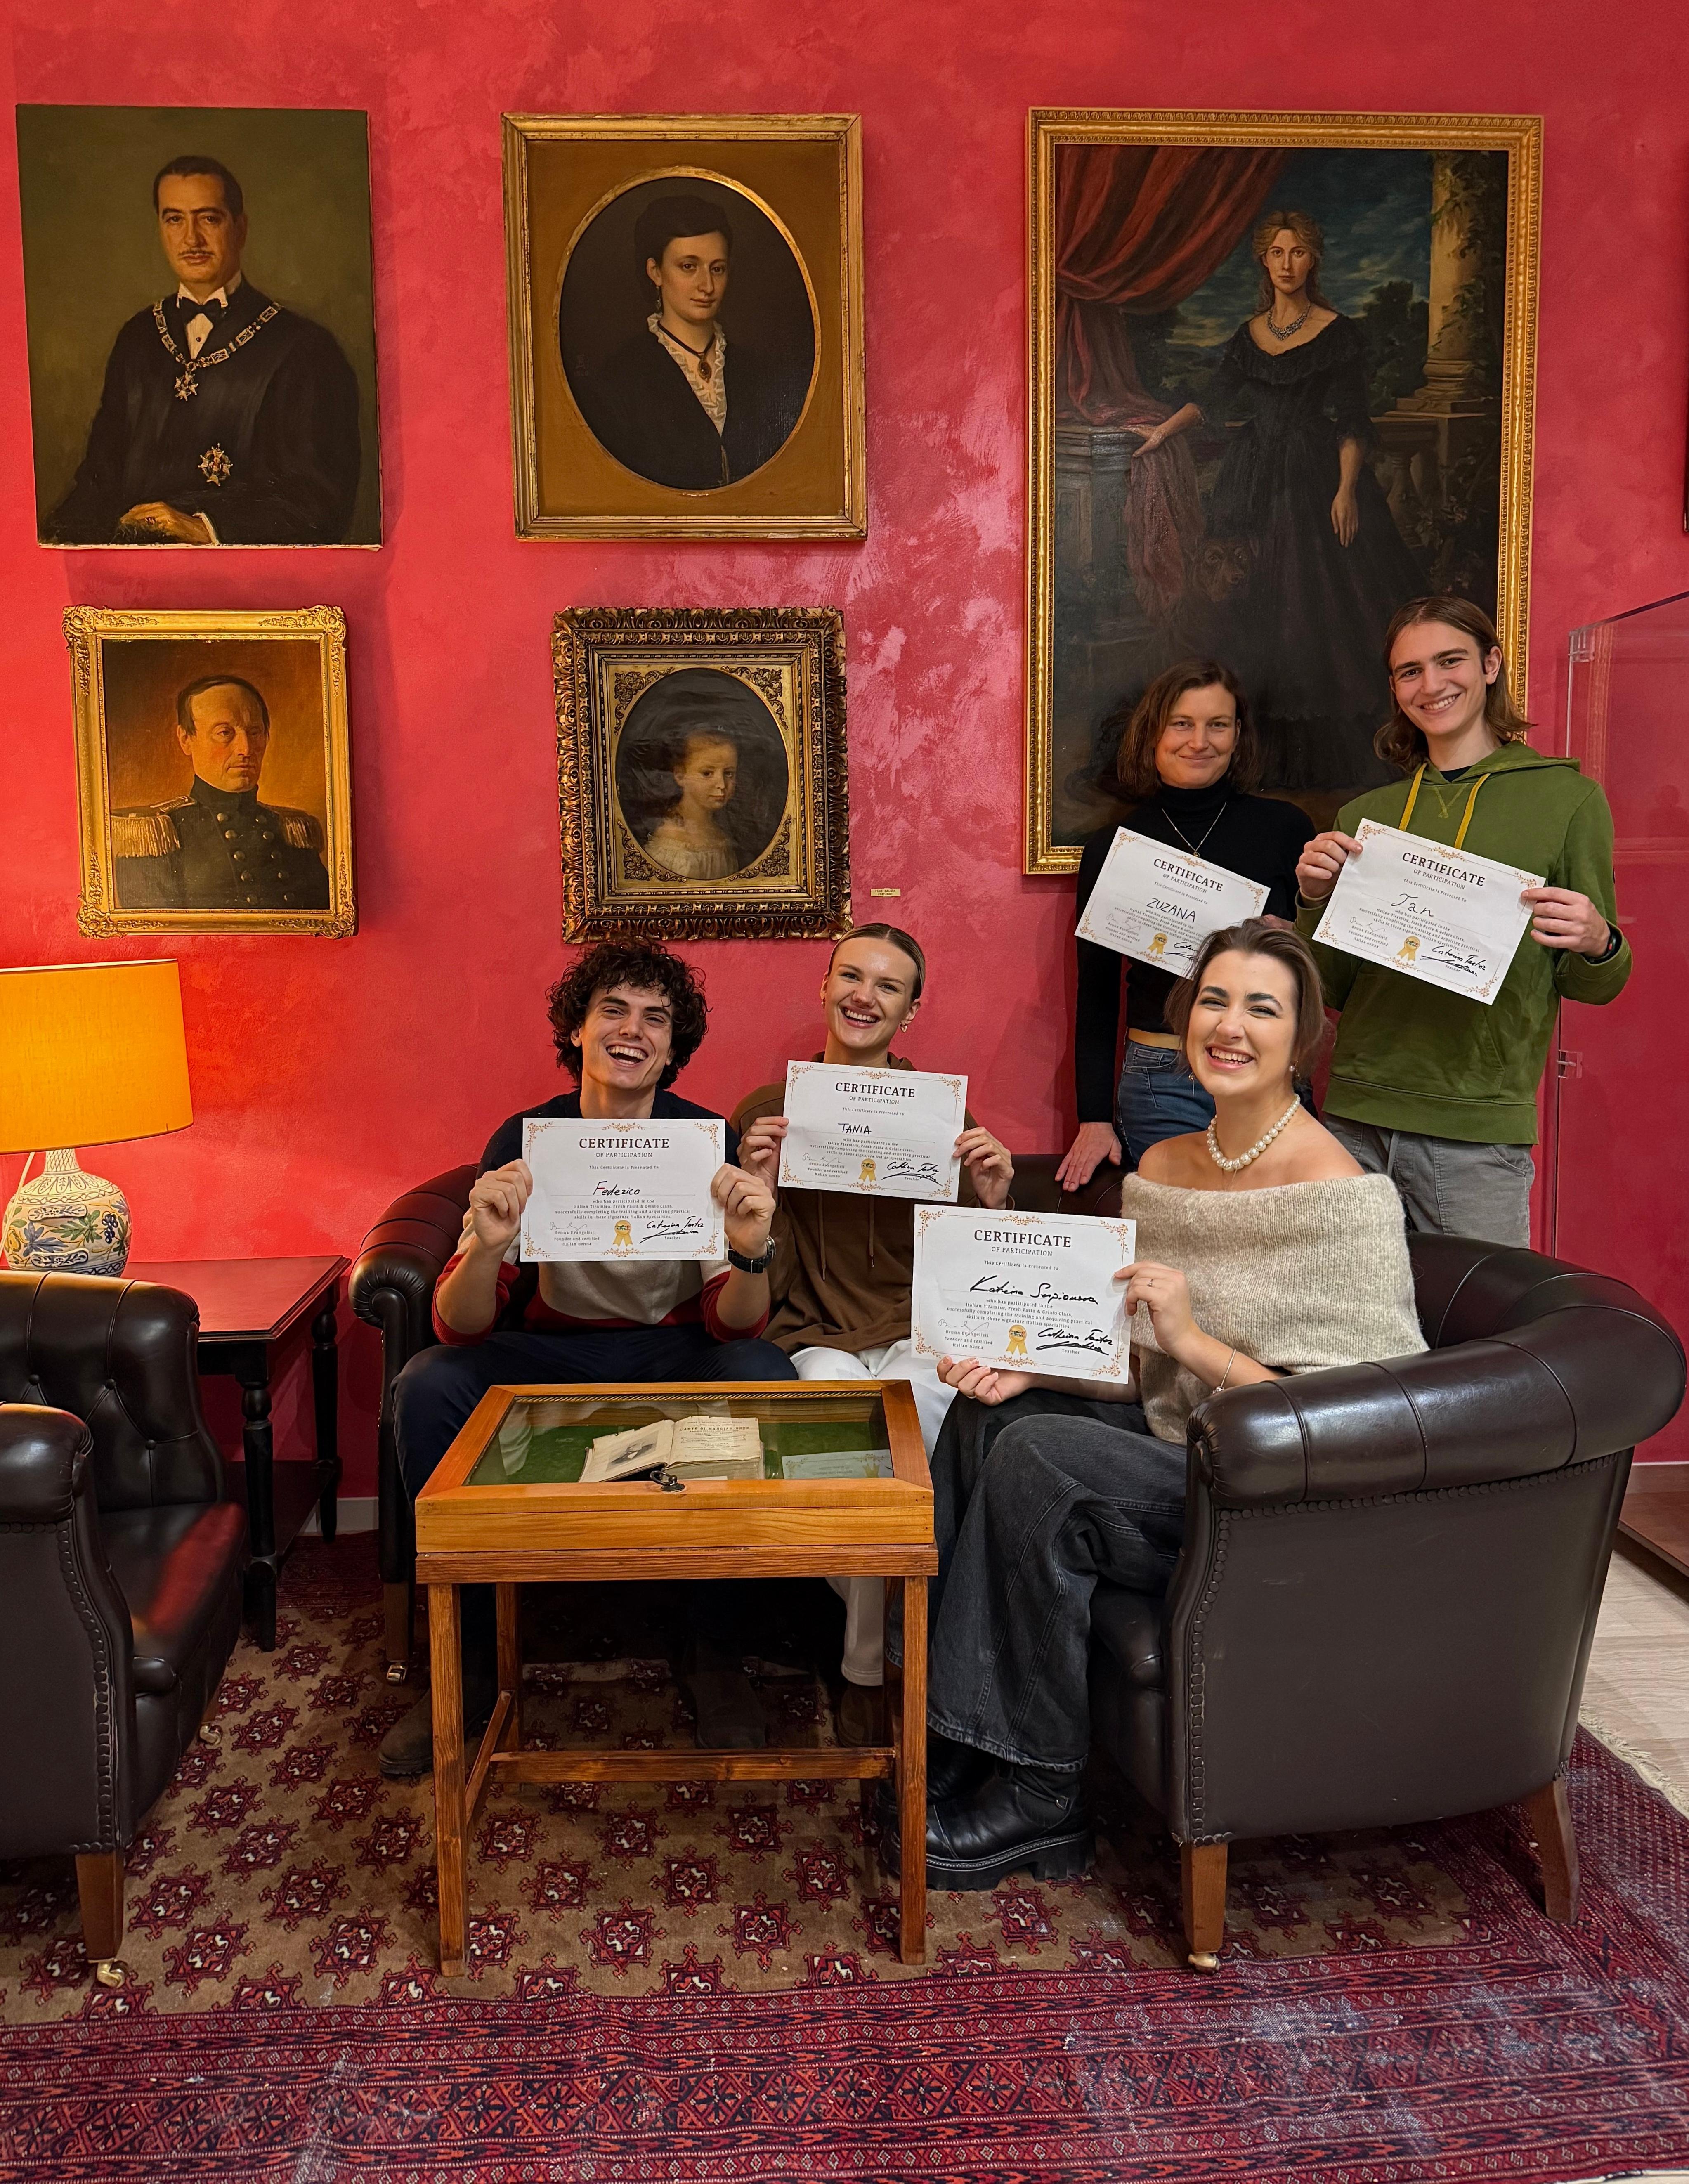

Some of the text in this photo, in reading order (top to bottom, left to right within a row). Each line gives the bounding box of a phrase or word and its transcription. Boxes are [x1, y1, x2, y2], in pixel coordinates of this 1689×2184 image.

[1153, 858, 1223, 891] CERTIFICATE
[1402, 852, 1485, 886] CERTIFICATE
[1170, 876, 1207, 893] PARTICIPATION
[1422, 872, 1465, 890] PARTICIPATION
[1146, 898, 1195, 923] ZUZANA
[835, 1082, 915, 1097] CERTIFICATE
[858, 1097, 899, 1105] PARTICIPATION
[837, 1123, 872, 1135] TANIA
[579, 1138, 669, 1148] CERTIFICATE
[593, 1180, 640, 1196] Federico
[974, 1229, 1071, 1248] CERTIFICATE
[1002, 1247, 1052, 1256] PARTICIPATION
